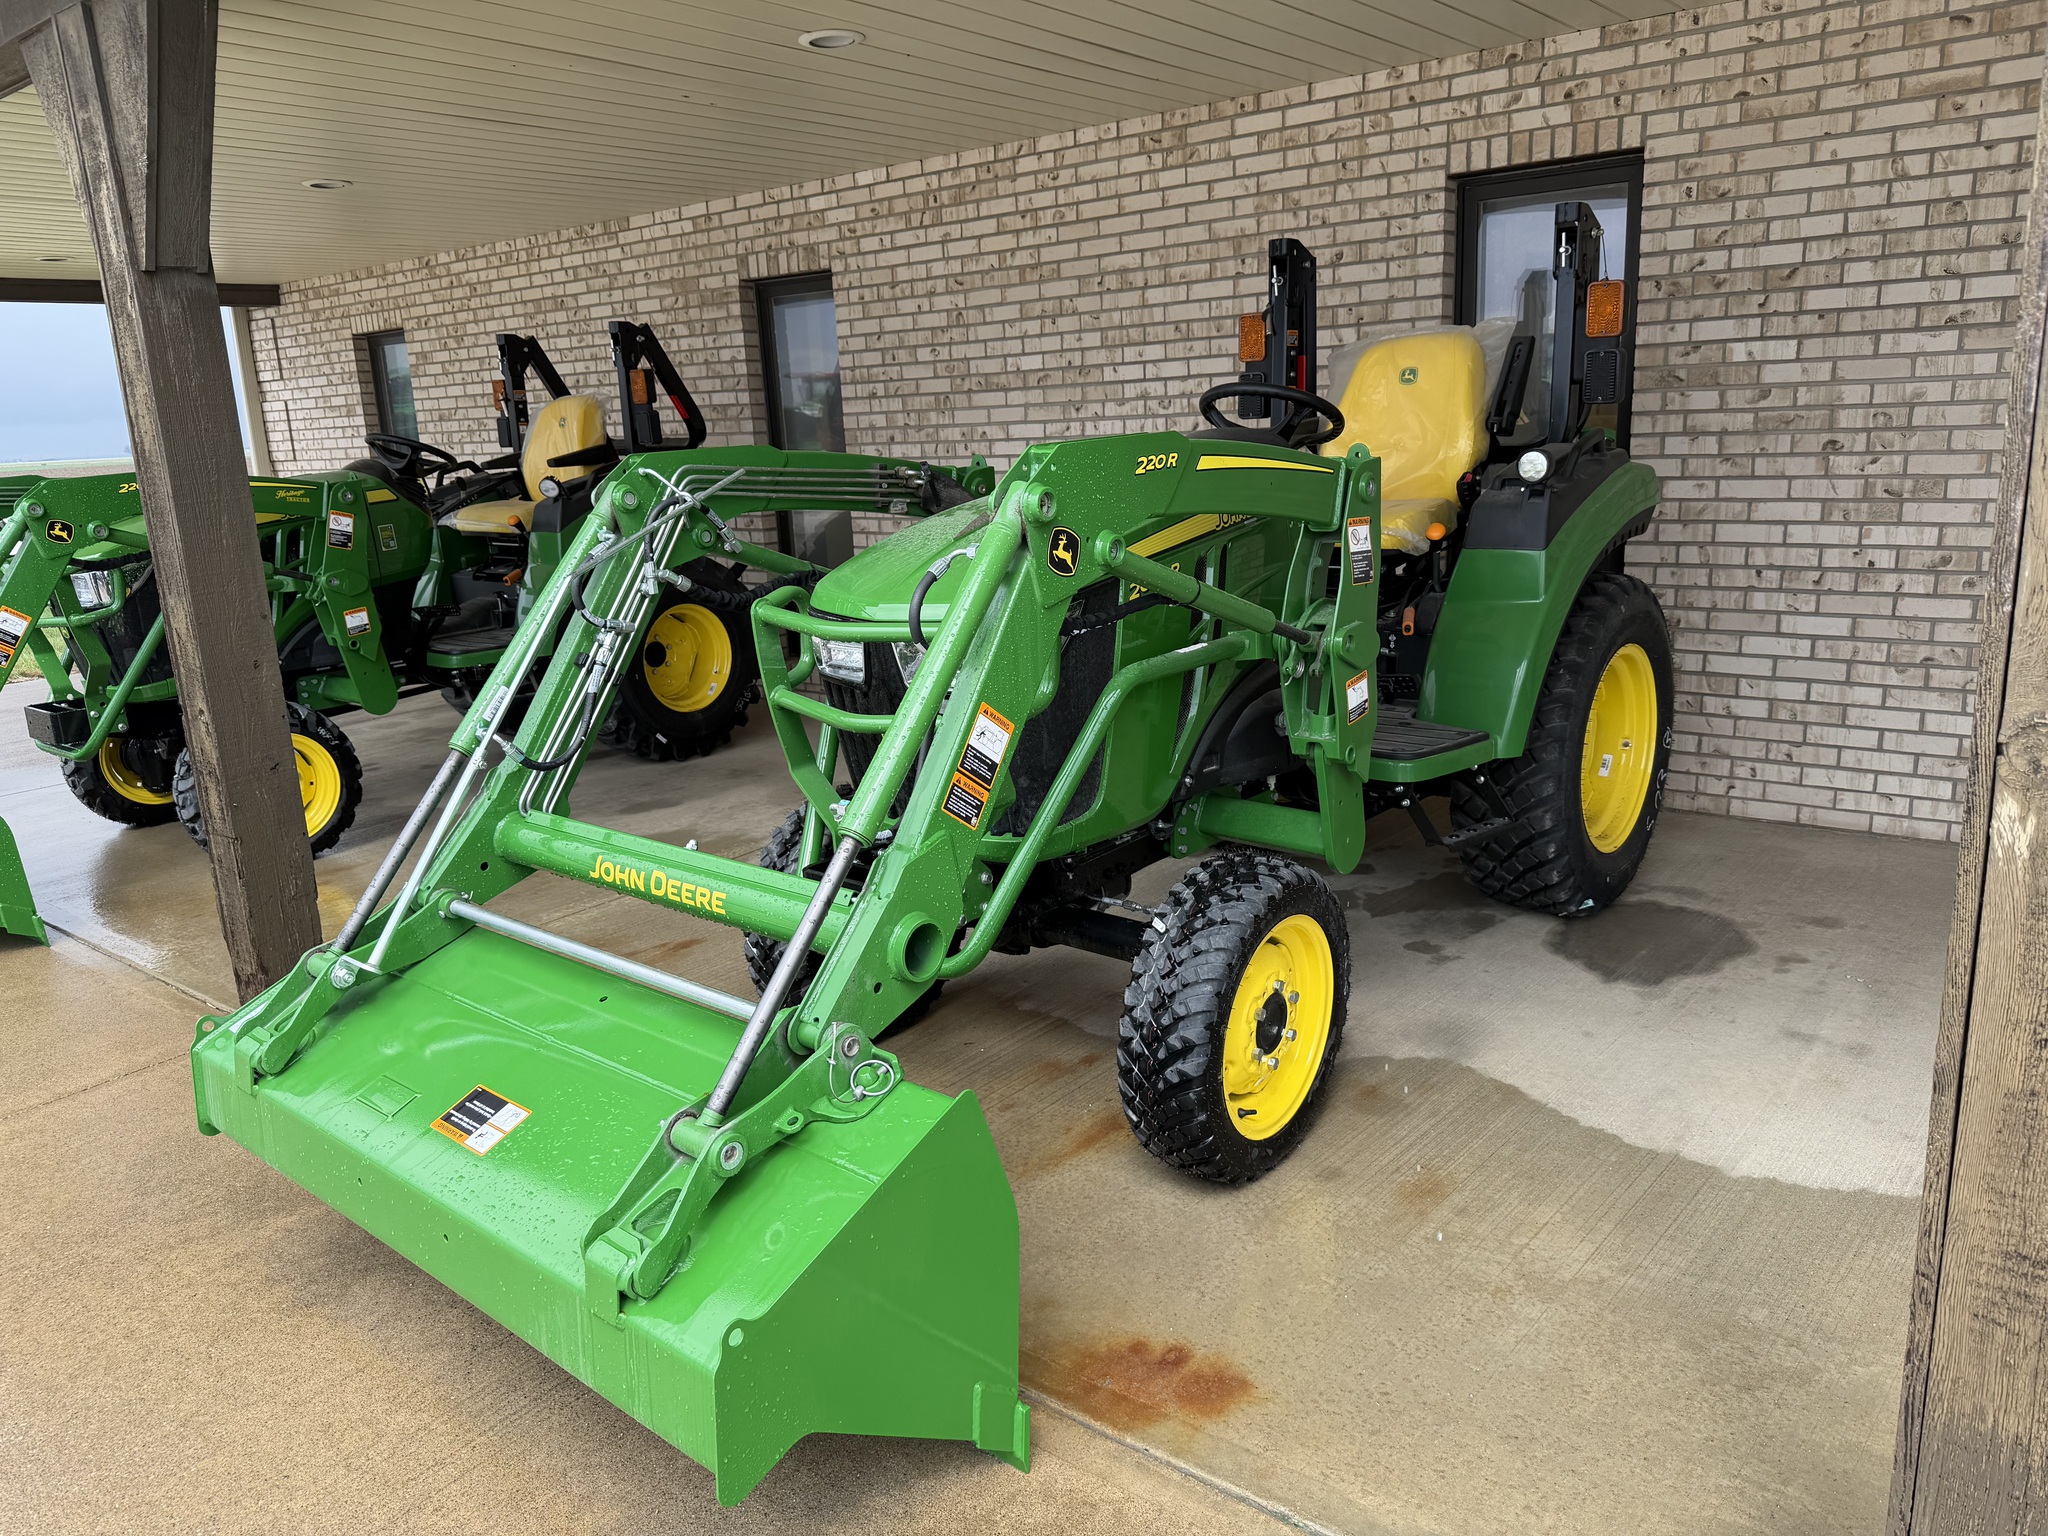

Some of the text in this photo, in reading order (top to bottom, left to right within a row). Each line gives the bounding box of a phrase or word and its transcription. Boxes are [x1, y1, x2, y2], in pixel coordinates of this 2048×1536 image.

[1135, 453, 1179, 475] 220 R
[118, 482, 140, 494] 22
[989, 711, 1010, 731] WARNING
[963, 780, 985, 800] WARNING
[589, 855, 727, 915] JOHN DEERE
